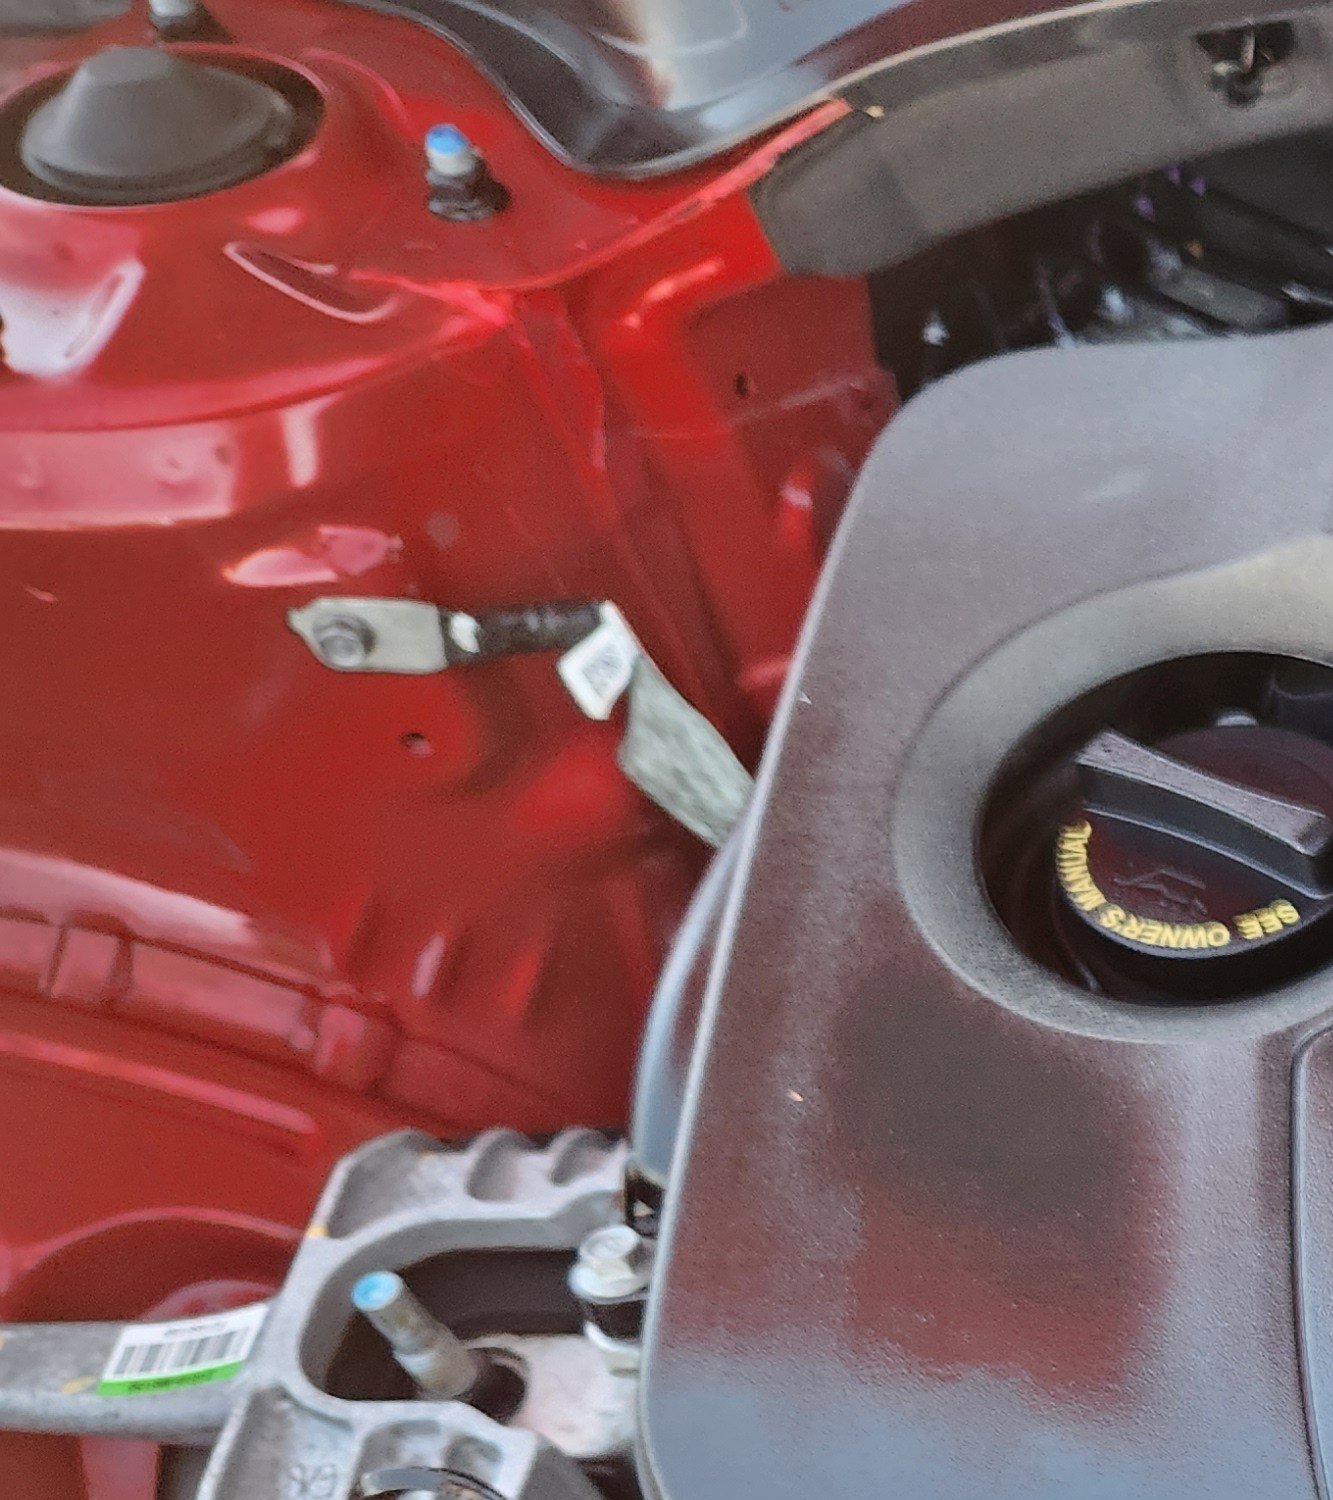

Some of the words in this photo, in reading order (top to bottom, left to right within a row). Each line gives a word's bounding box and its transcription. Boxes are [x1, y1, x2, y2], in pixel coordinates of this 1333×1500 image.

[1056, 819, 1107, 911] MANUAL
[1100, 903, 1231, 949] OWNER'S
[1232, 898, 1300, 939] SEE
